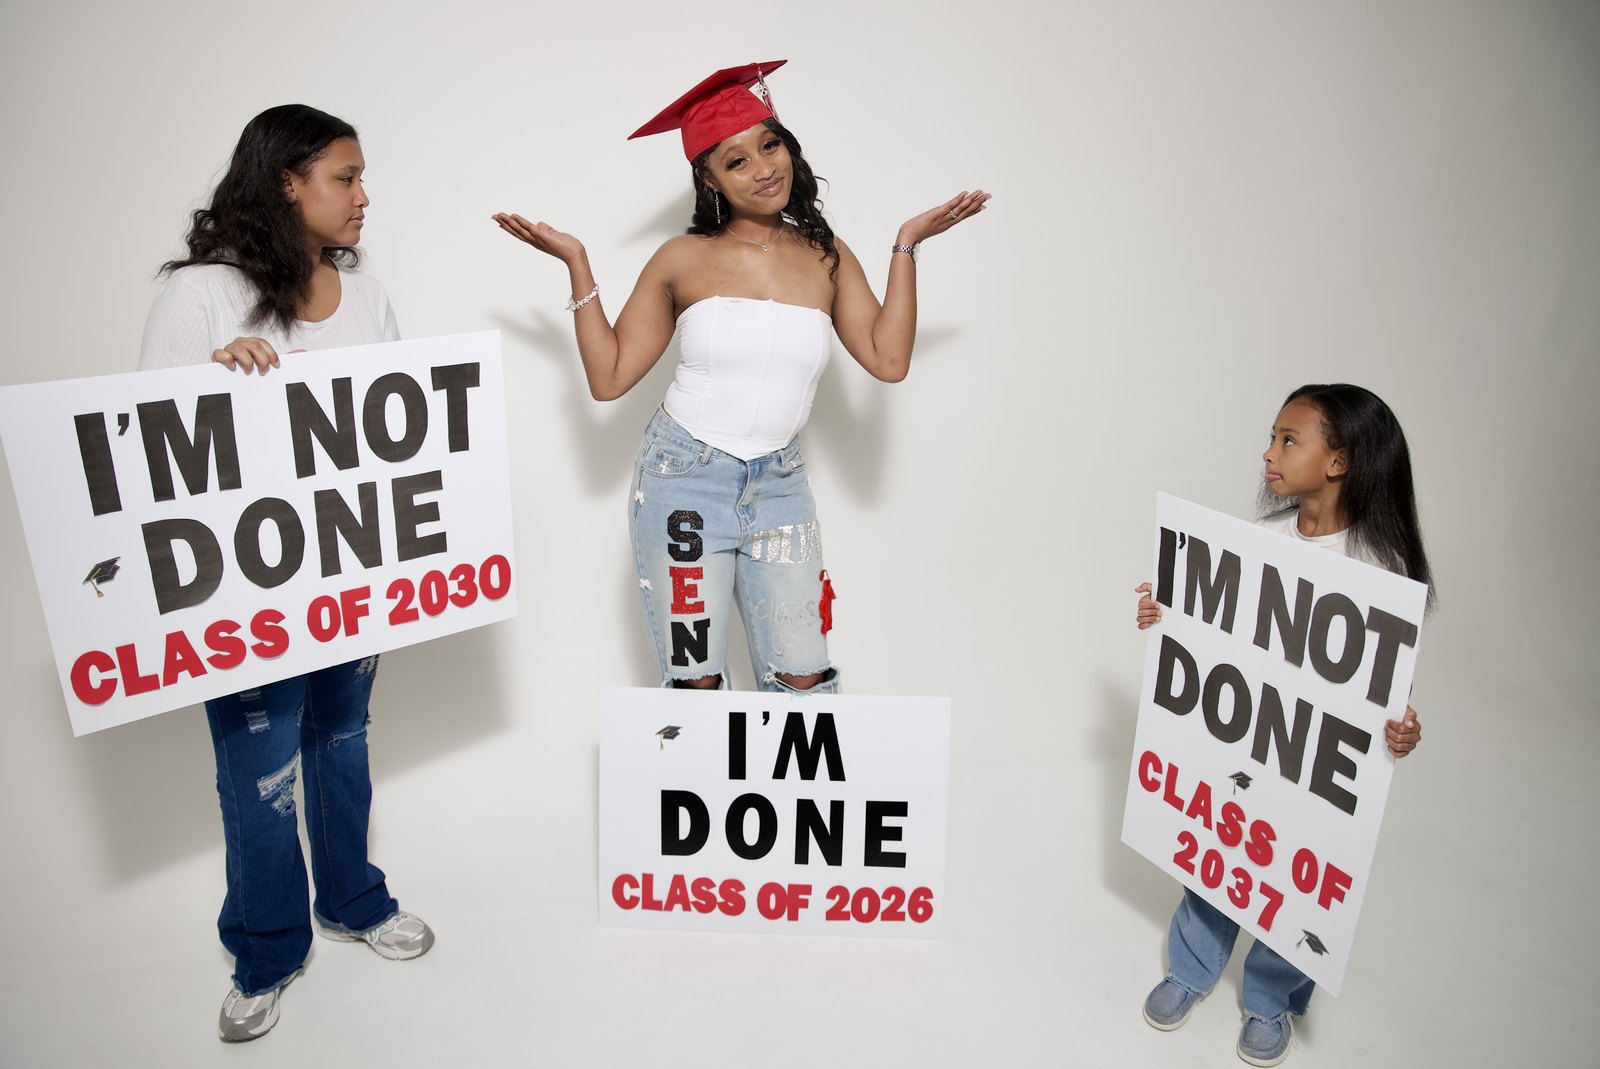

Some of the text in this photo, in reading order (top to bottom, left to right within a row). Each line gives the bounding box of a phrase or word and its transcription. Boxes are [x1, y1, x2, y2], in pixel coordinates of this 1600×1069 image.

[73, 361, 480, 517] I'M NOT
[141, 469, 447, 616] DONE
[667, 509, 711, 667] SEN
[1156, 526, 1418, 709] I'M NOT
[70, 554, 512, 706] CLASS OF 2030
[728, 711, 847, 782] I'M
[1153, 634, 1372, 817] DONE
[612, 873, 934, 924] CLASS OF 2026
[660, 789, 909, 869] DONE
[1138, 751, 1353, 911] CLASS OF
[1172, 830, 1284, 933] 2037
